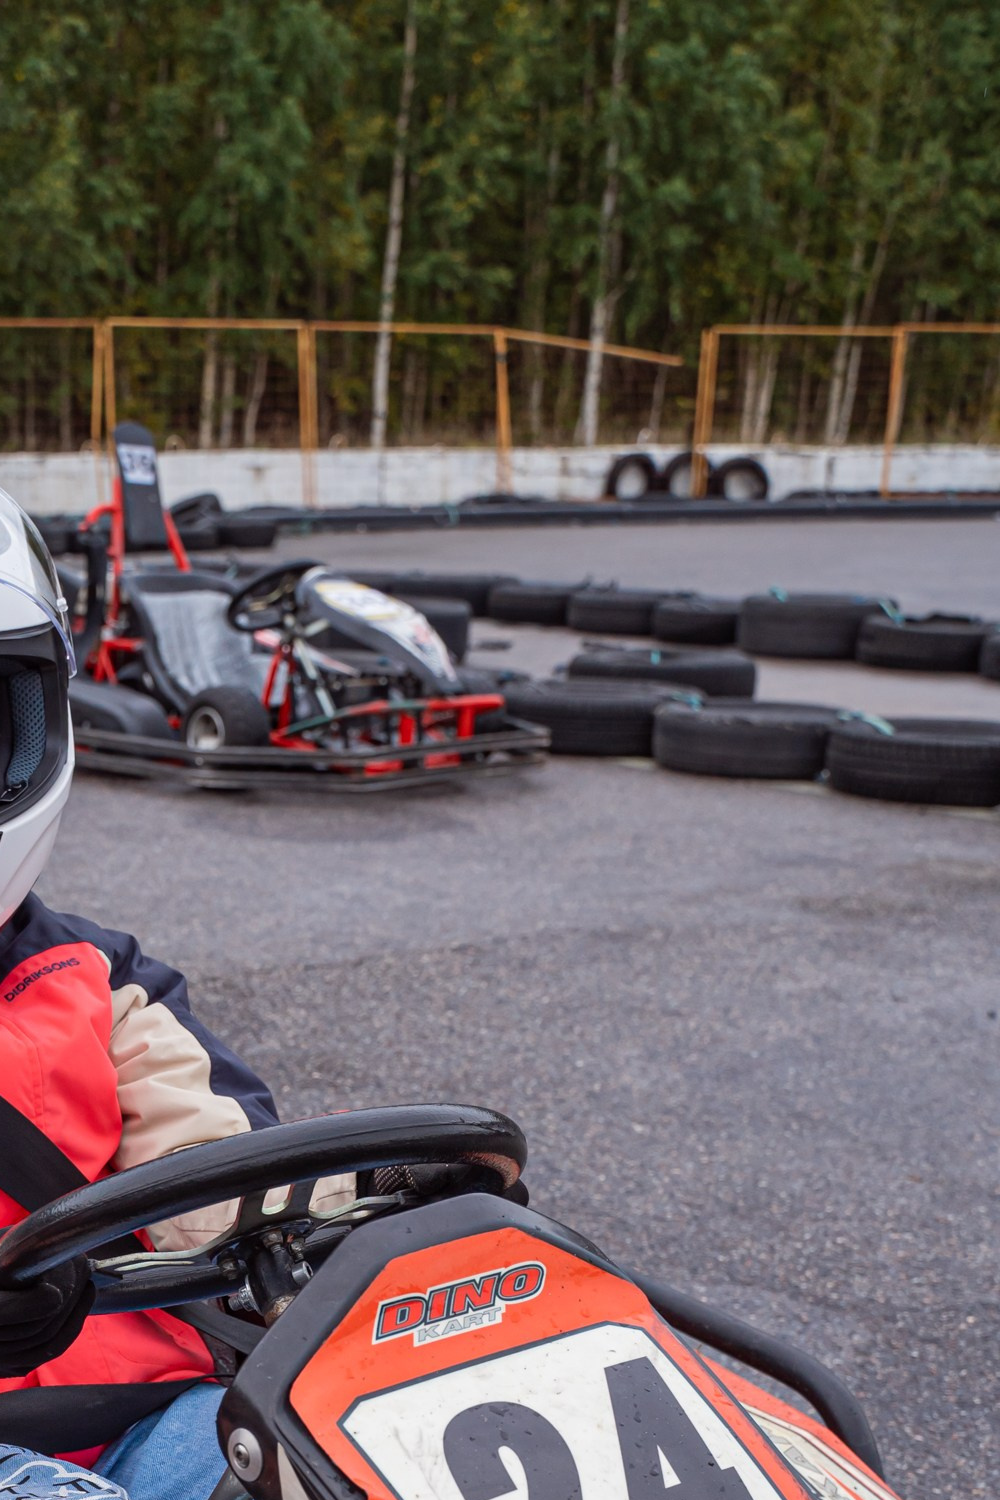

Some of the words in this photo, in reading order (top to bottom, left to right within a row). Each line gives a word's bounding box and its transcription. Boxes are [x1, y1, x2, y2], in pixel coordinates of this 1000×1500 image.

[3, 957, 81, 1003] DIDRIKSONS
[375, 1263, 545, 1341] DINO
[417, 1307, 502, 1343] KART
